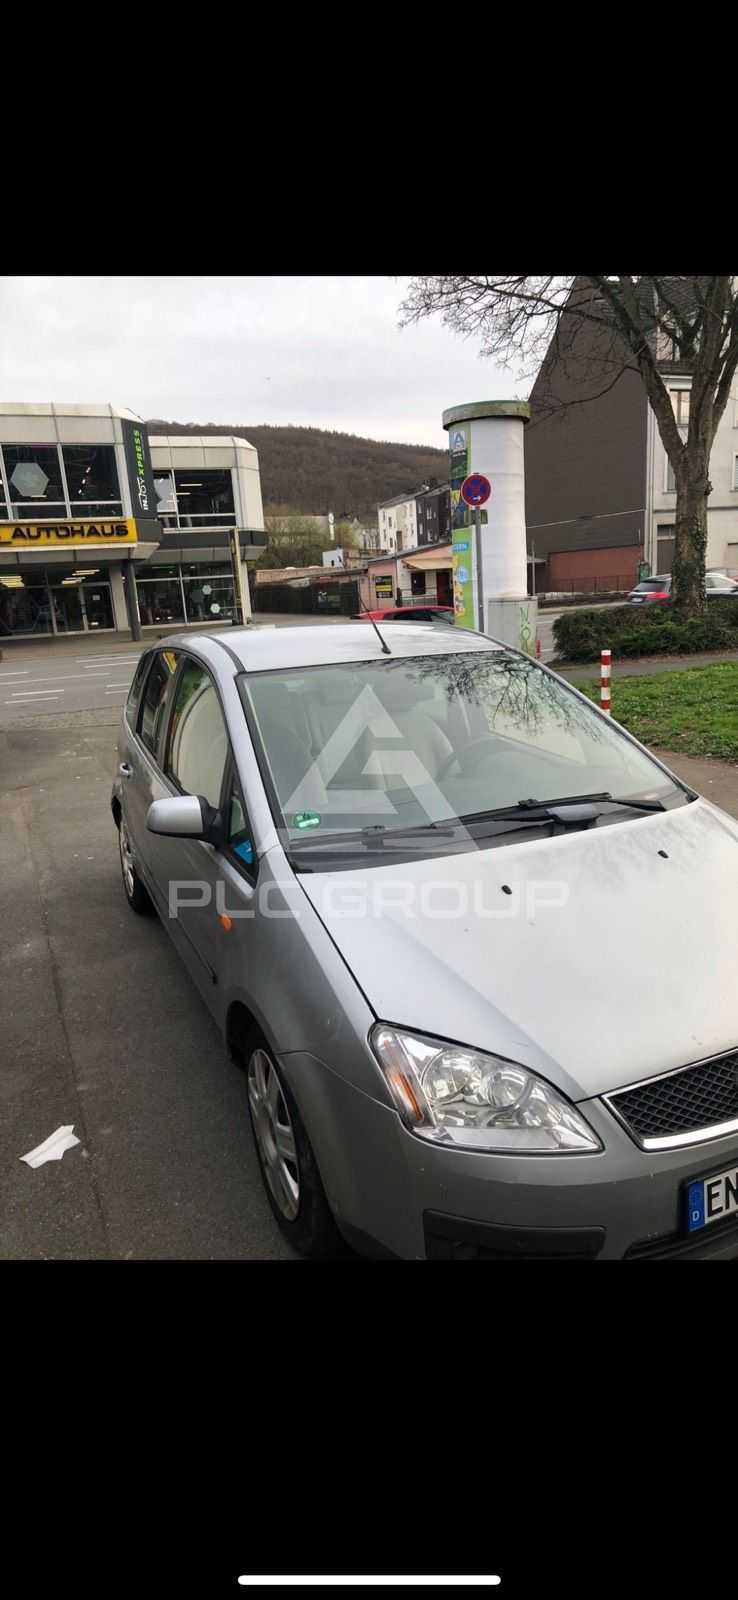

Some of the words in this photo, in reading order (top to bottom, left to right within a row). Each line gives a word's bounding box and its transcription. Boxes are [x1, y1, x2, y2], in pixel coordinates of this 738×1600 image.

[133, 430, 144, 476] XPRESS
[137, 477, 149, 510] INJOY
[11, 525, 129, 539] AUTOHAUS
[692, 1210, 700, 1221] D
